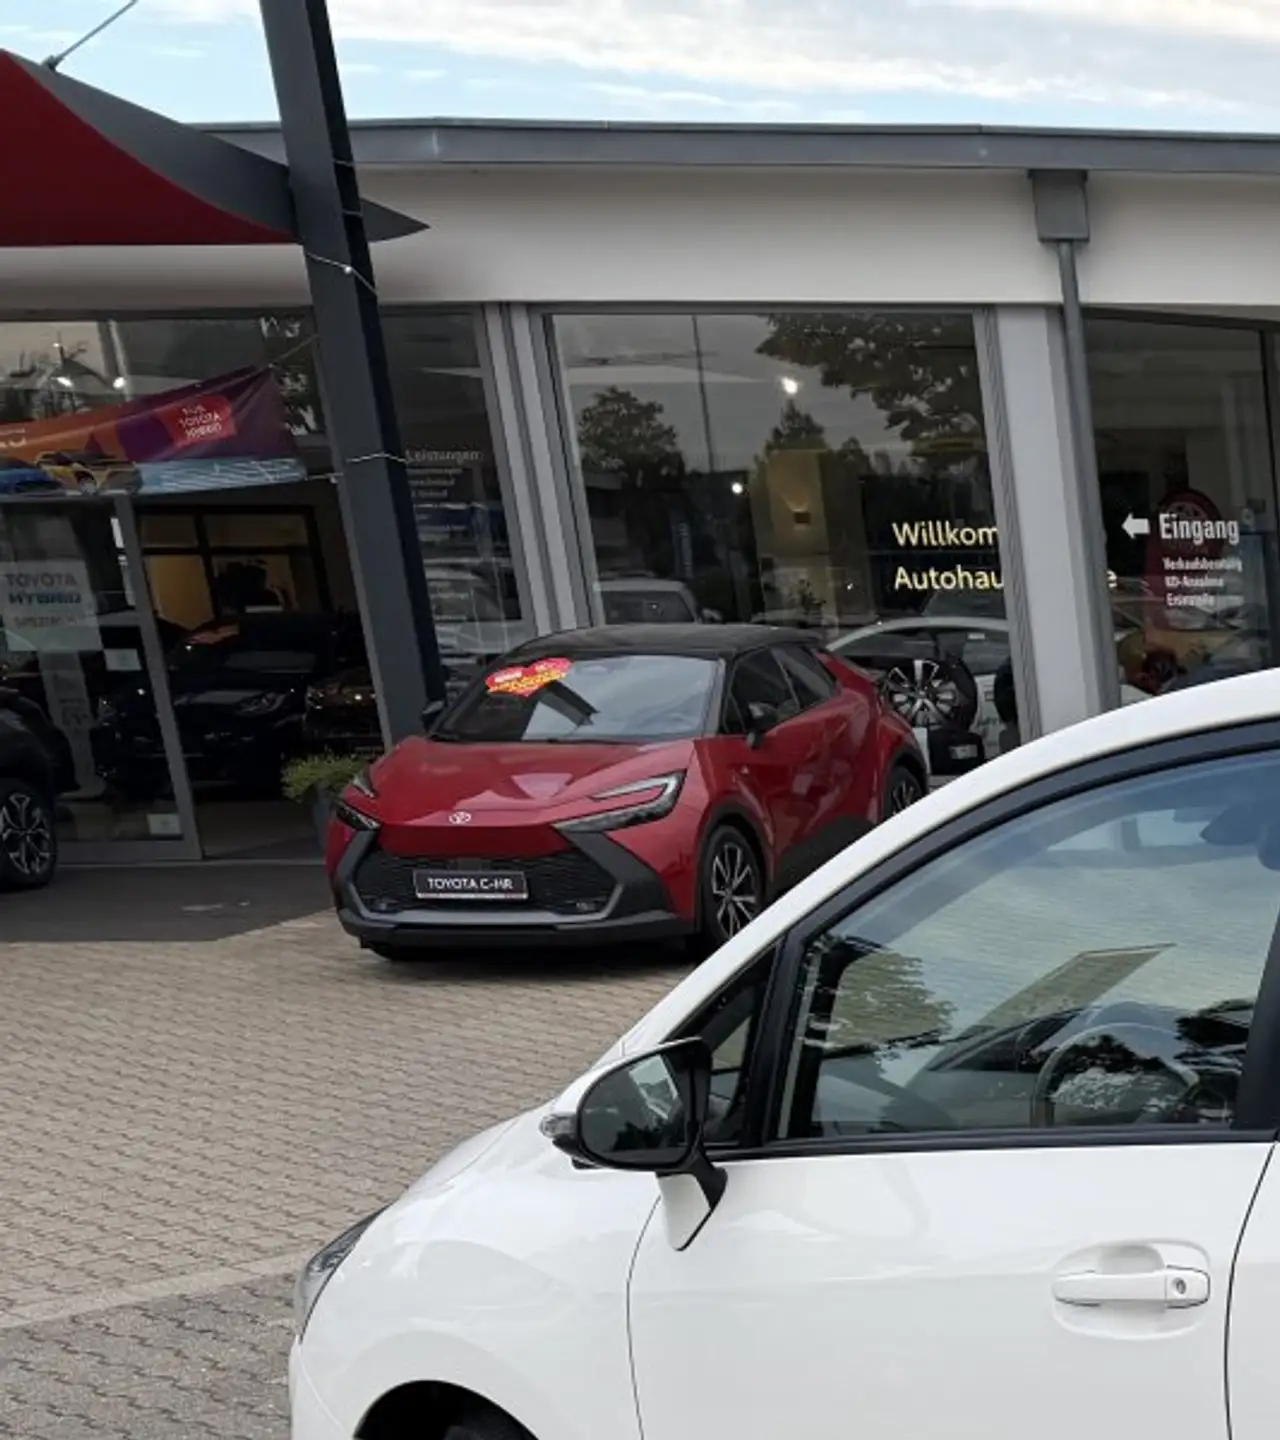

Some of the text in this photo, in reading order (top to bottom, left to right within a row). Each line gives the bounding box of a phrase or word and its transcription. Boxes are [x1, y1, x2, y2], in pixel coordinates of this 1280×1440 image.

[1159, 513, 1240, 545] Eingang
[428, 877, 514, 890] TOYOTA C-HR
